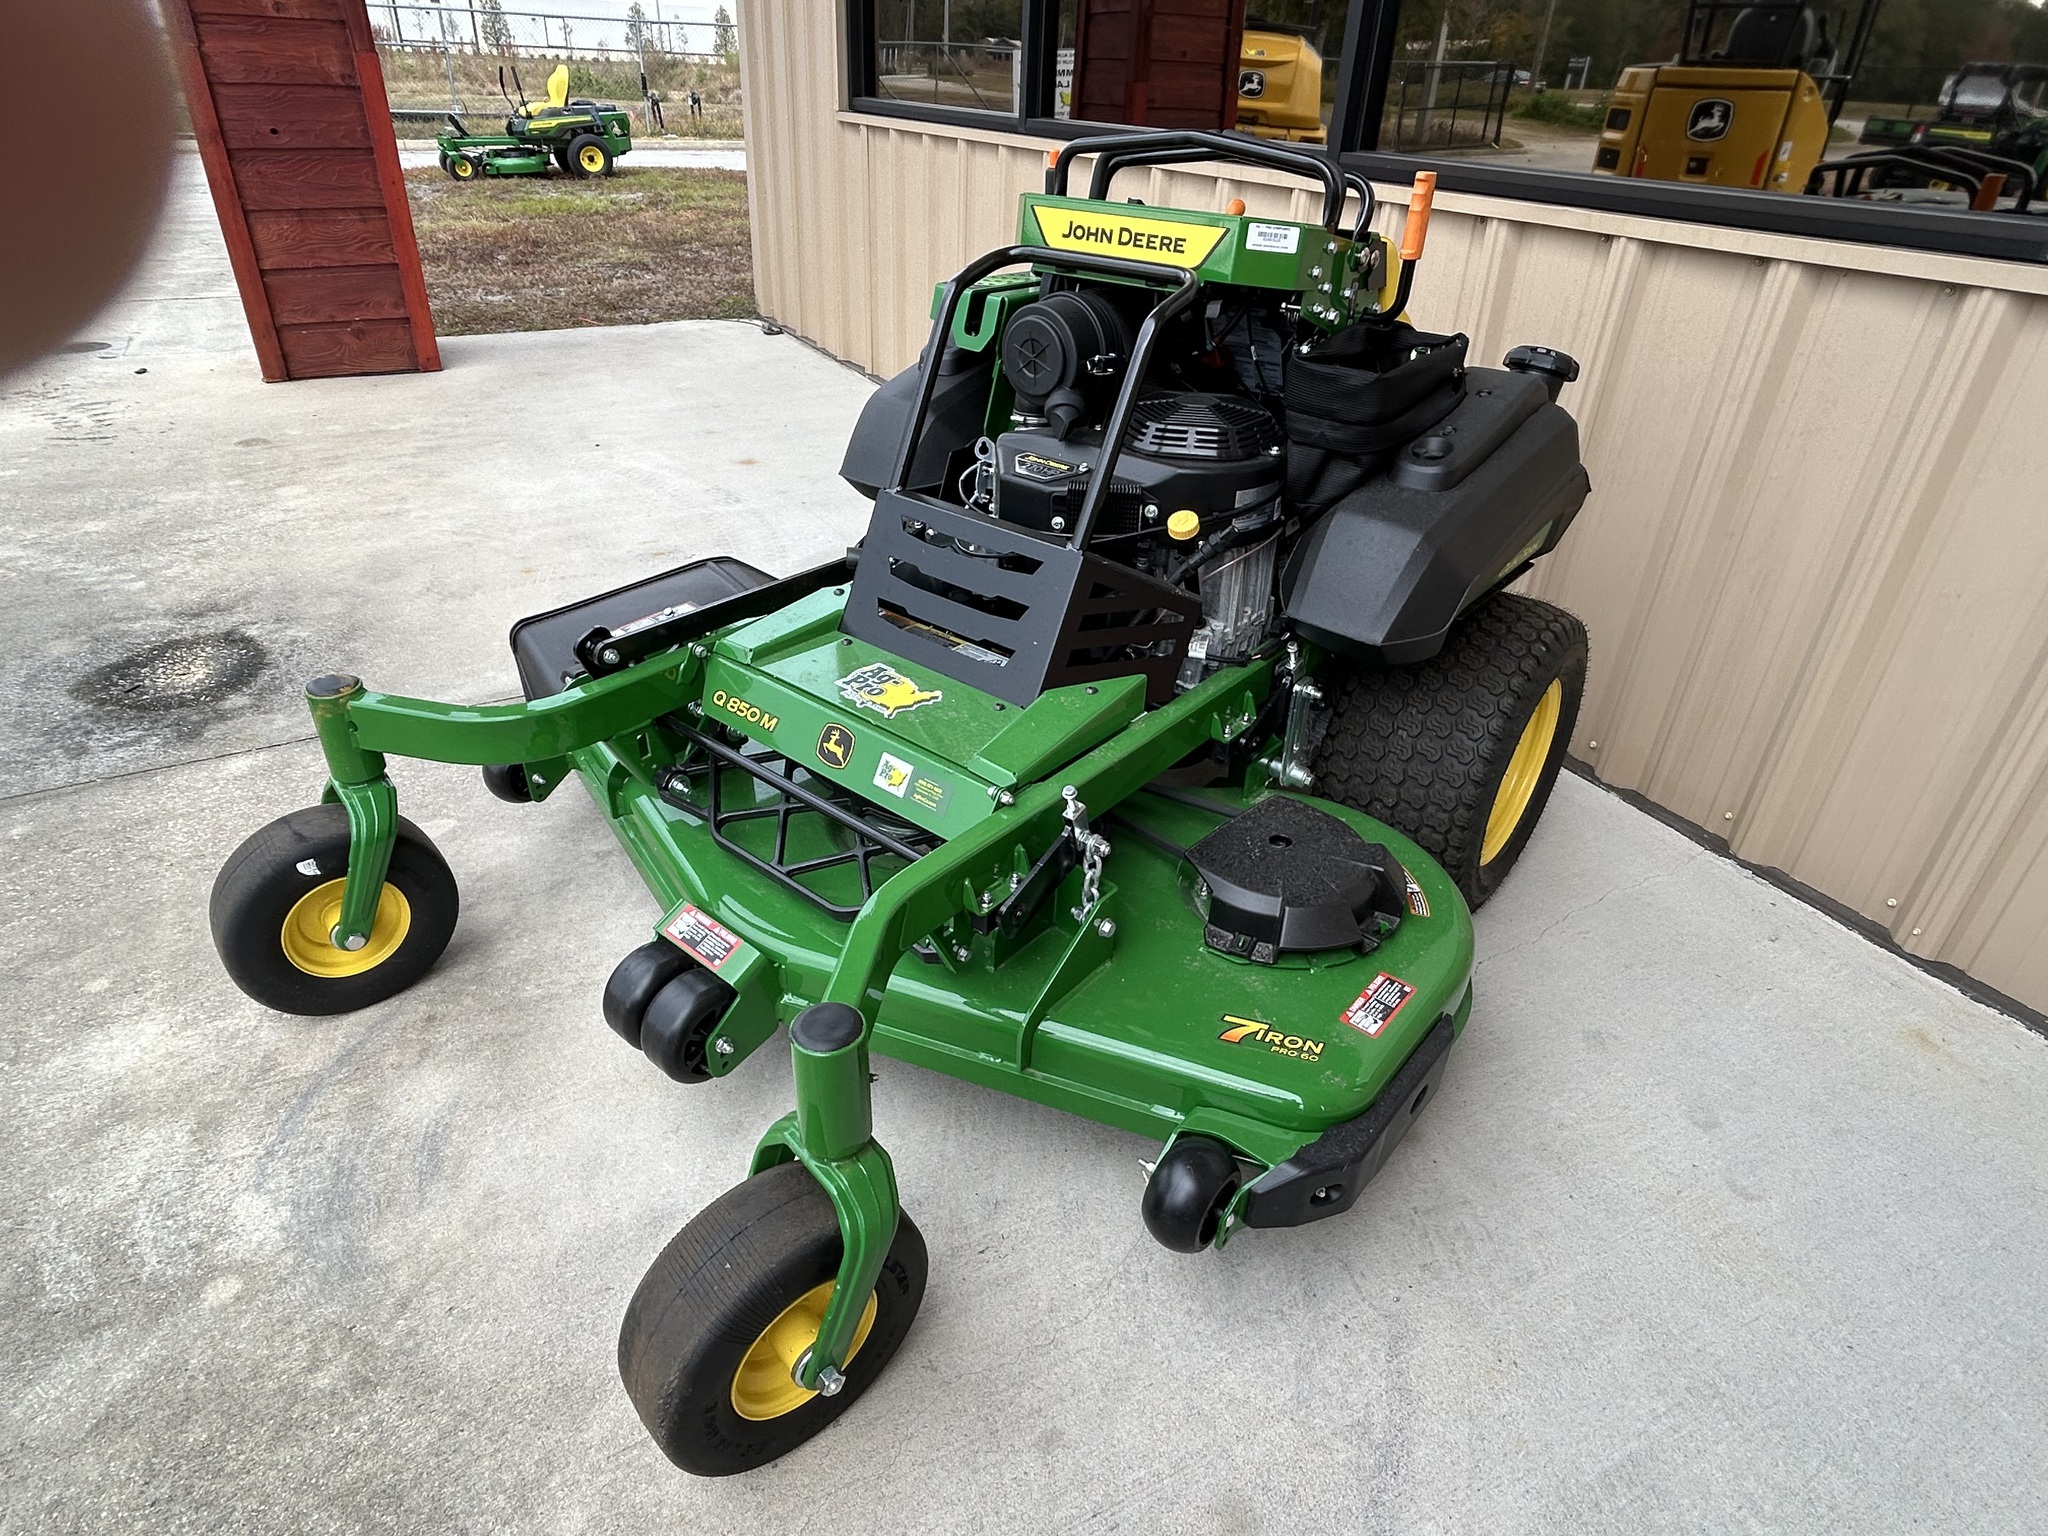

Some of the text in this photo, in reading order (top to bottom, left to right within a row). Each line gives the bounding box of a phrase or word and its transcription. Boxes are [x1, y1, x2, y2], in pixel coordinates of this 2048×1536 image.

[1061, 220, 1187, 254] JOHN DEERE
[842, 674, 885, 696] Pro
[712, 689, 780, 732] Q 850 M
[879, 768, 893, 781] Pro
[1218, 1013, 1325, 1055] 7 IRON
[1270, 1045, 1320, 1063] PRO 60
